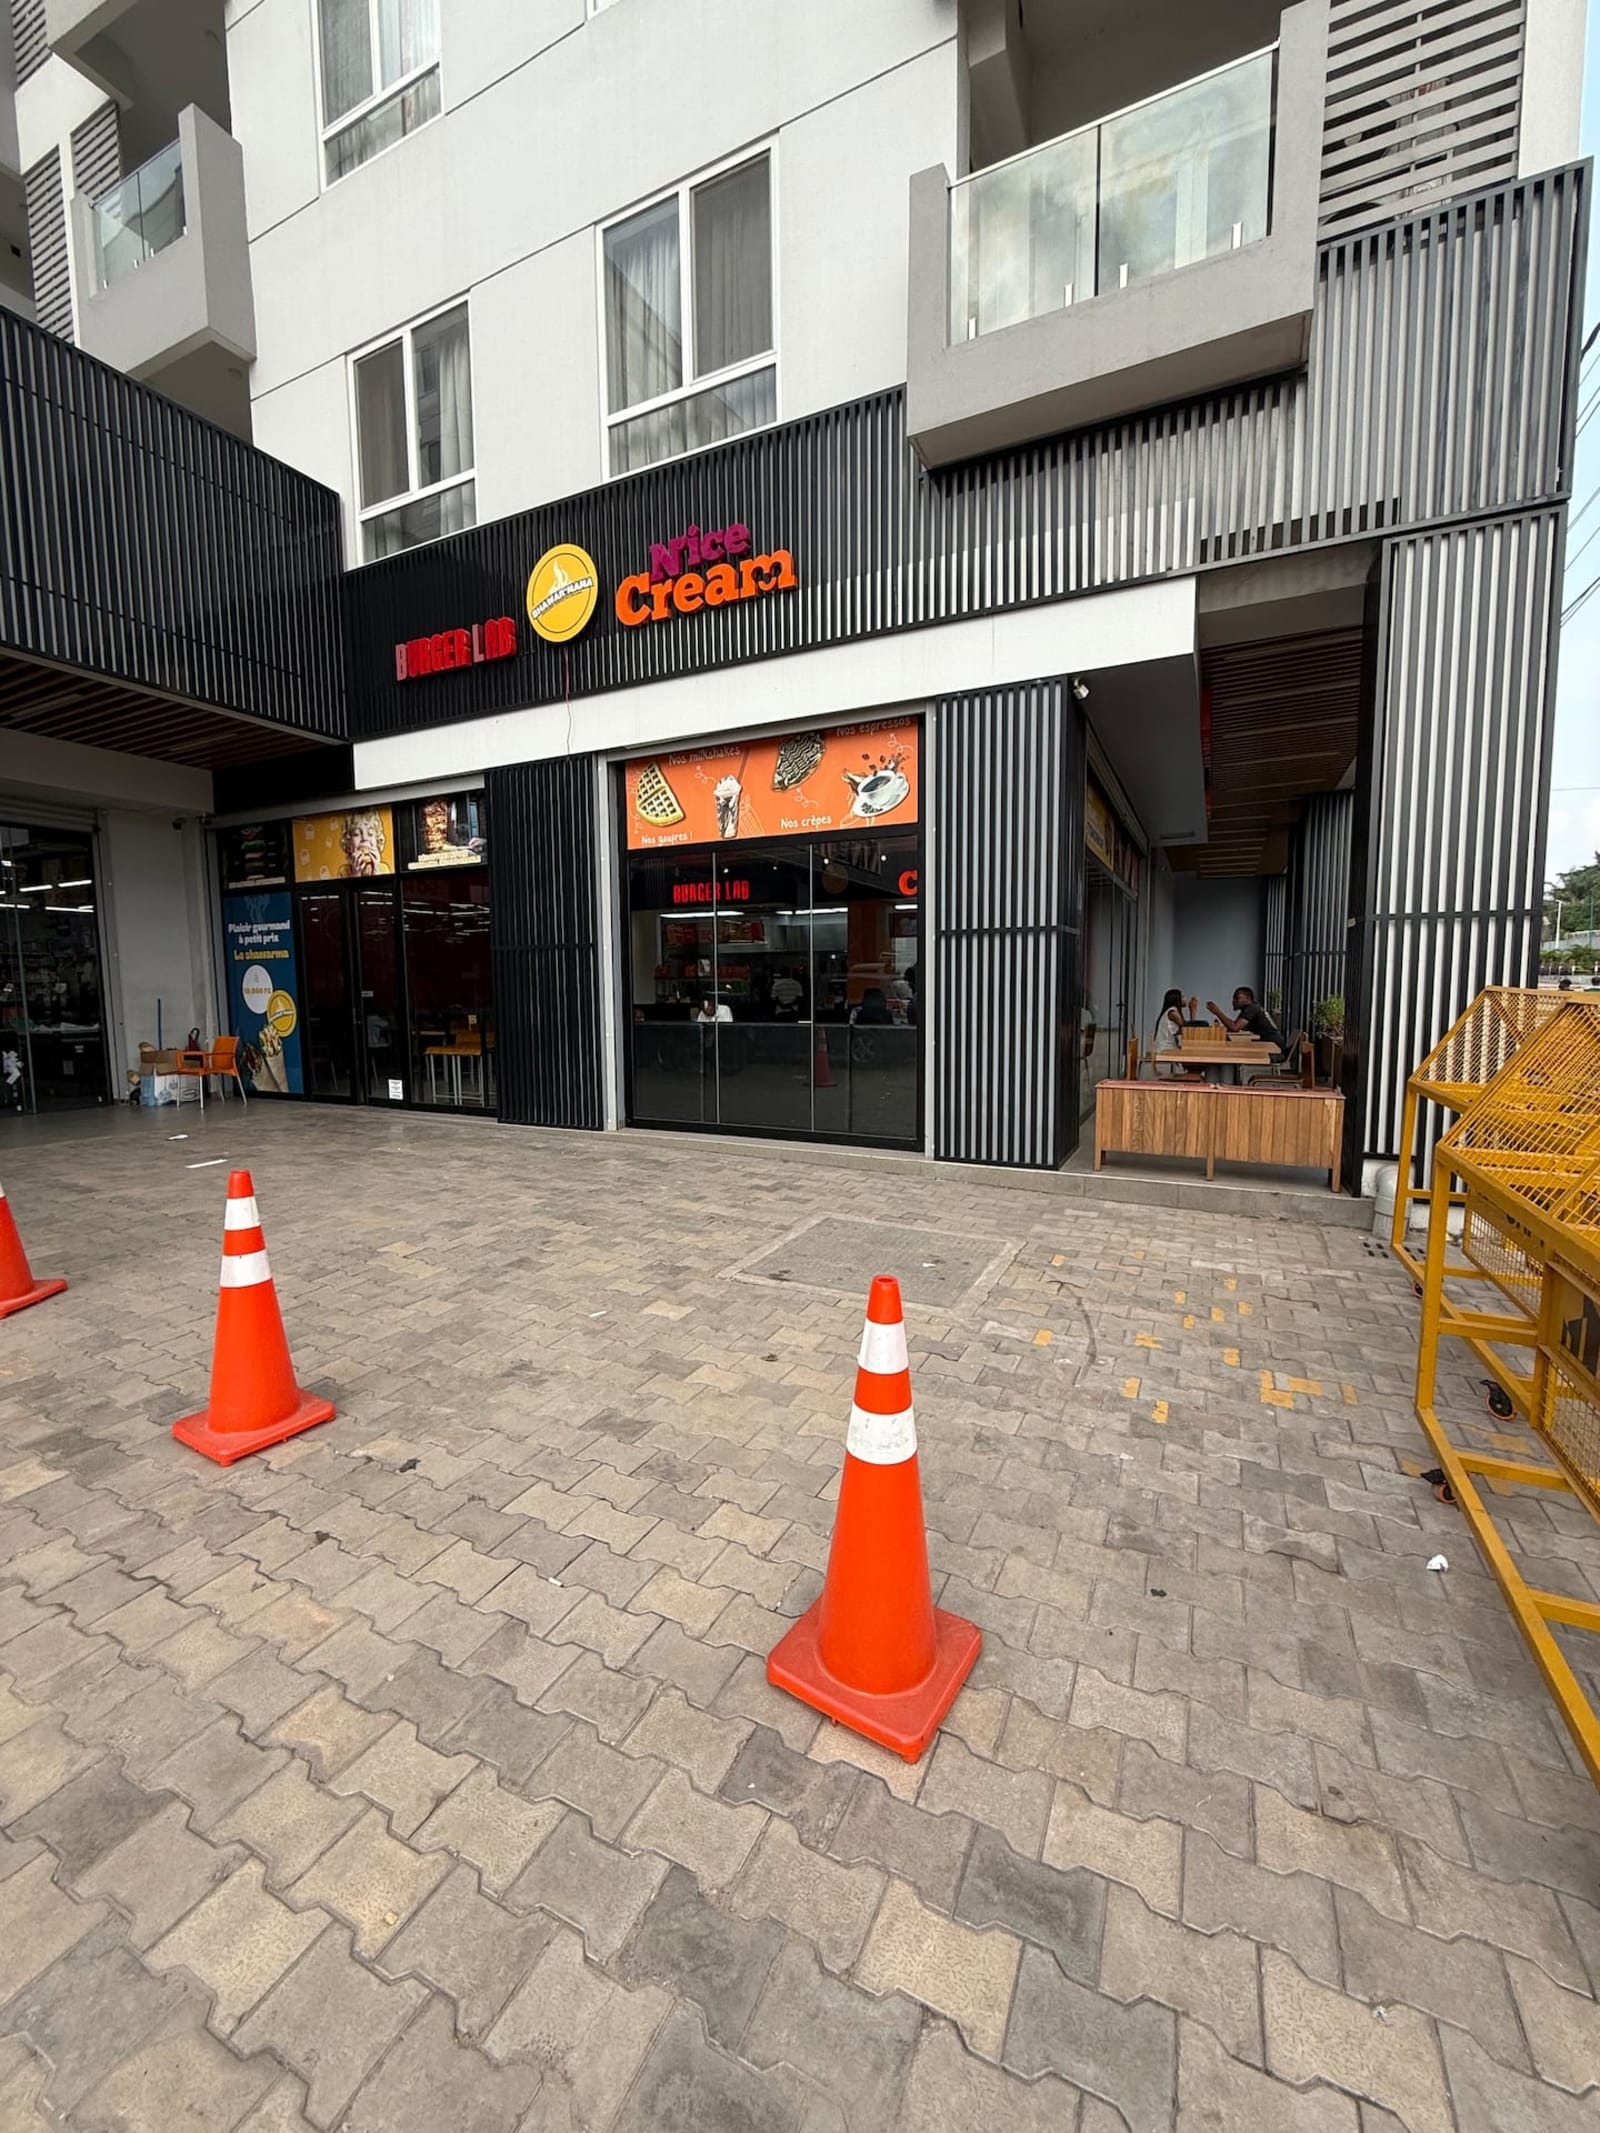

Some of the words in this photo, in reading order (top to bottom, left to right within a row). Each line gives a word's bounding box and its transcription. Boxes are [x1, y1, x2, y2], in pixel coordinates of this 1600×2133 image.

[649, 523, 751, 582] Nice
[615, 549, 797, 627] Cream
[395, 628, 472, 681] BURGER
[472, 616, 516, 663] LAB
[836, 727, 856, 737] Nos
[859, 717, 912, 735] espressos
[668, 753, 687, 767] Nos
[689, 745, 741, 763] milkshakes
[780, 817, 798, 830] Nos
[801, 814, 833, 829] crêpes
[641, 834, 657, 847] Nos
[673, 882, 721, 904] BURGER
[725, 879, 749, 900] LAB
[252, 919, 290, 934] gourmand
[244, 932, 262, 946] petit
[263, 931, 280, 945] prix
